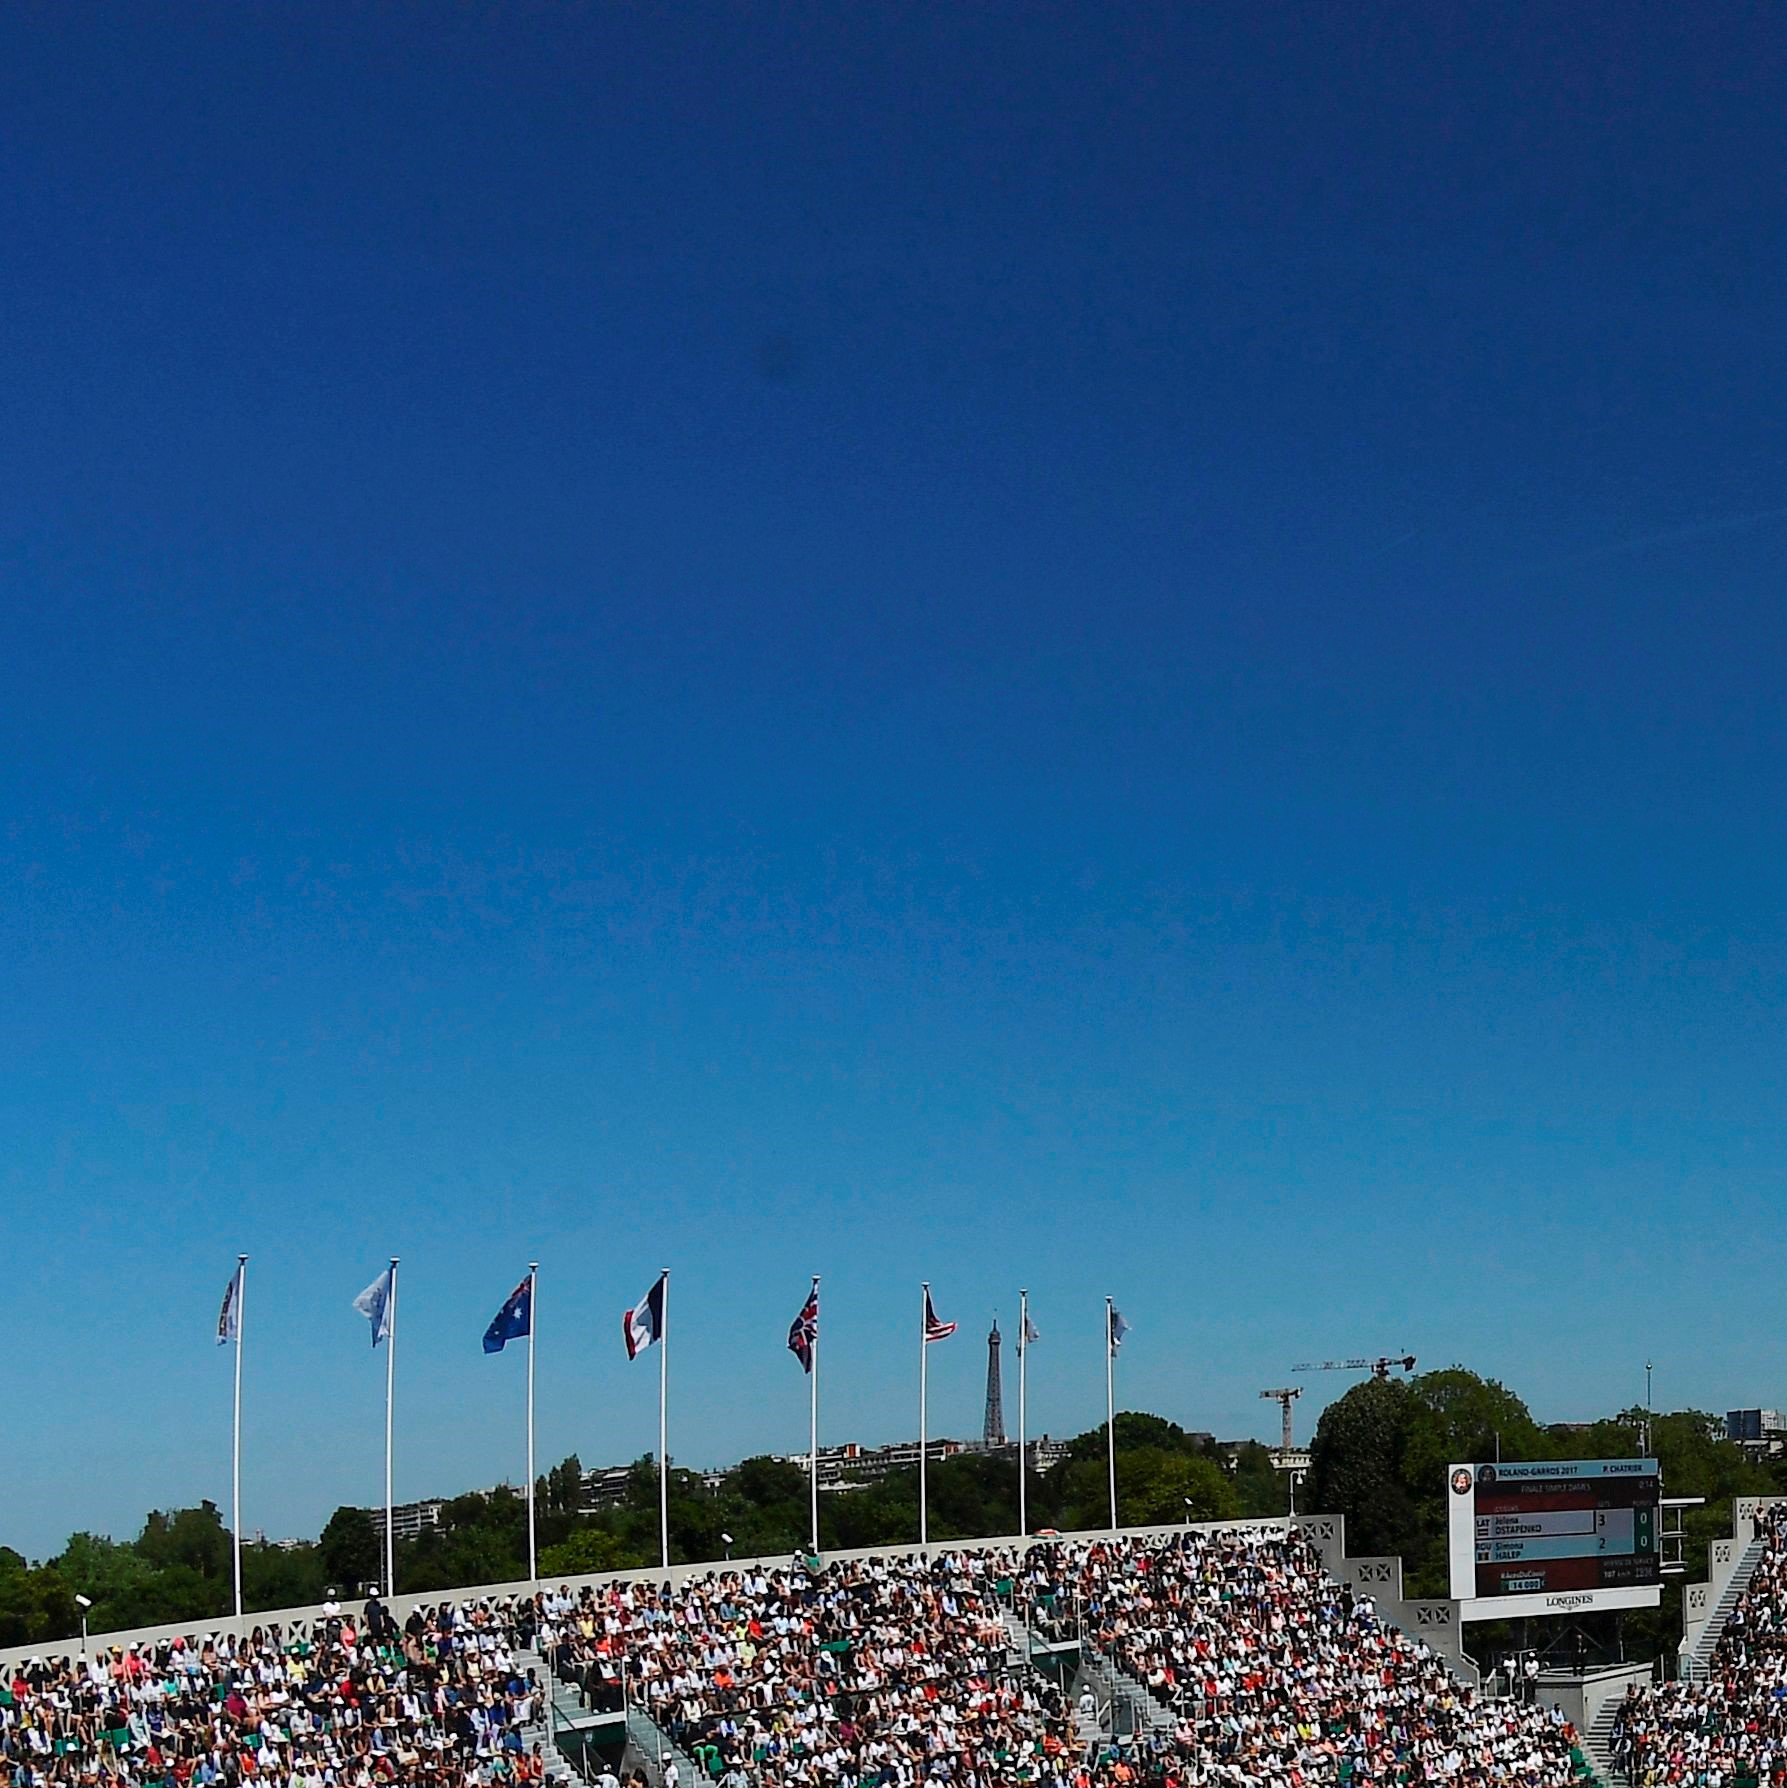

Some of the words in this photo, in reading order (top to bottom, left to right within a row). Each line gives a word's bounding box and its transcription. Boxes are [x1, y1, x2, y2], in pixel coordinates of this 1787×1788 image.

[1561, 1466, 1578, 1475] 2017
[1476, 1519, 1490, 1527] LAT
[1598, 1514, 1606, 1526] 3
[1640, 1512, 1648, 1524] 0
[1495, 1542, 1523, 1551] Simona
[1599, 1538, 1606, 1550] 2
[1640, 1535, 1648, 1547] 0
[1495, 1551, 1521, 1560] HALEP
[1546, 1595, 1593, 1607] LONGINES
